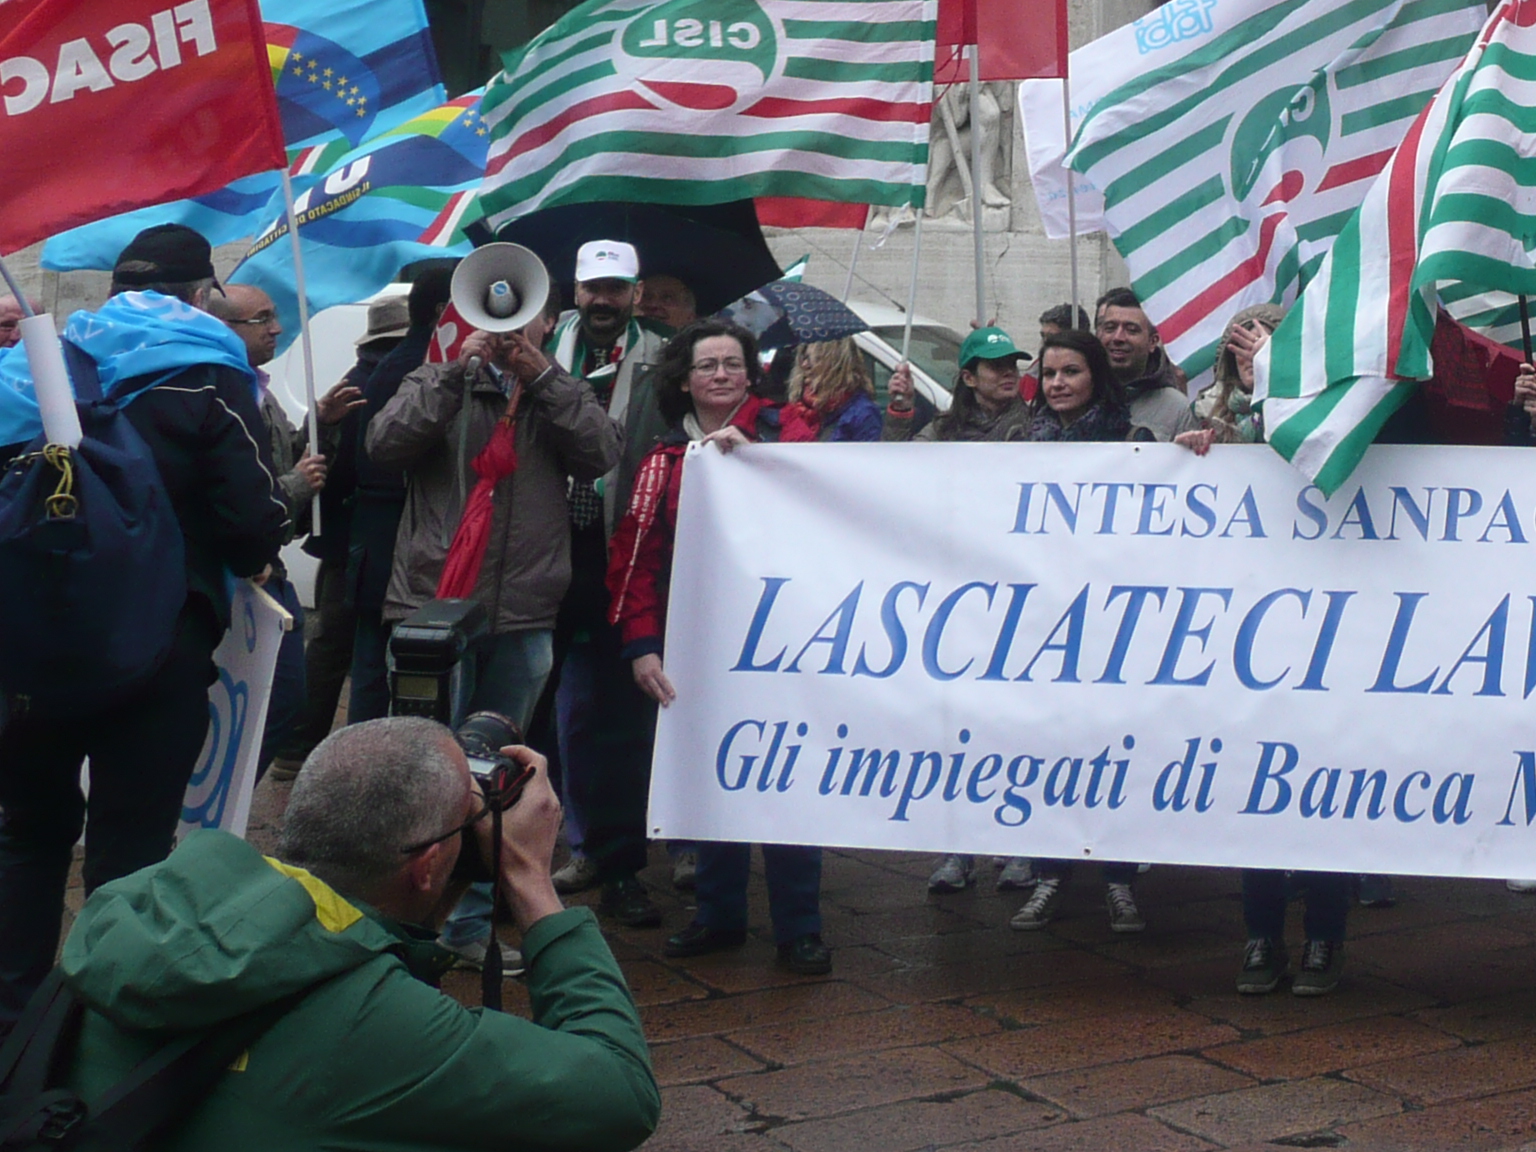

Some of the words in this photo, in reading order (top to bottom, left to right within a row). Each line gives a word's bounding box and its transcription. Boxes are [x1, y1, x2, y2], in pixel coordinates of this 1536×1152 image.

[1008, 482, 1268, 539] INTESA
[730, 575, 1358, 692] LASCIATECI
[716, 717, 808, 795] Gli
[818, 723, 1137, 828] impiegati
[1153, 736, 1224, 815] di
[1238, 740, 1477, 827] Banca
